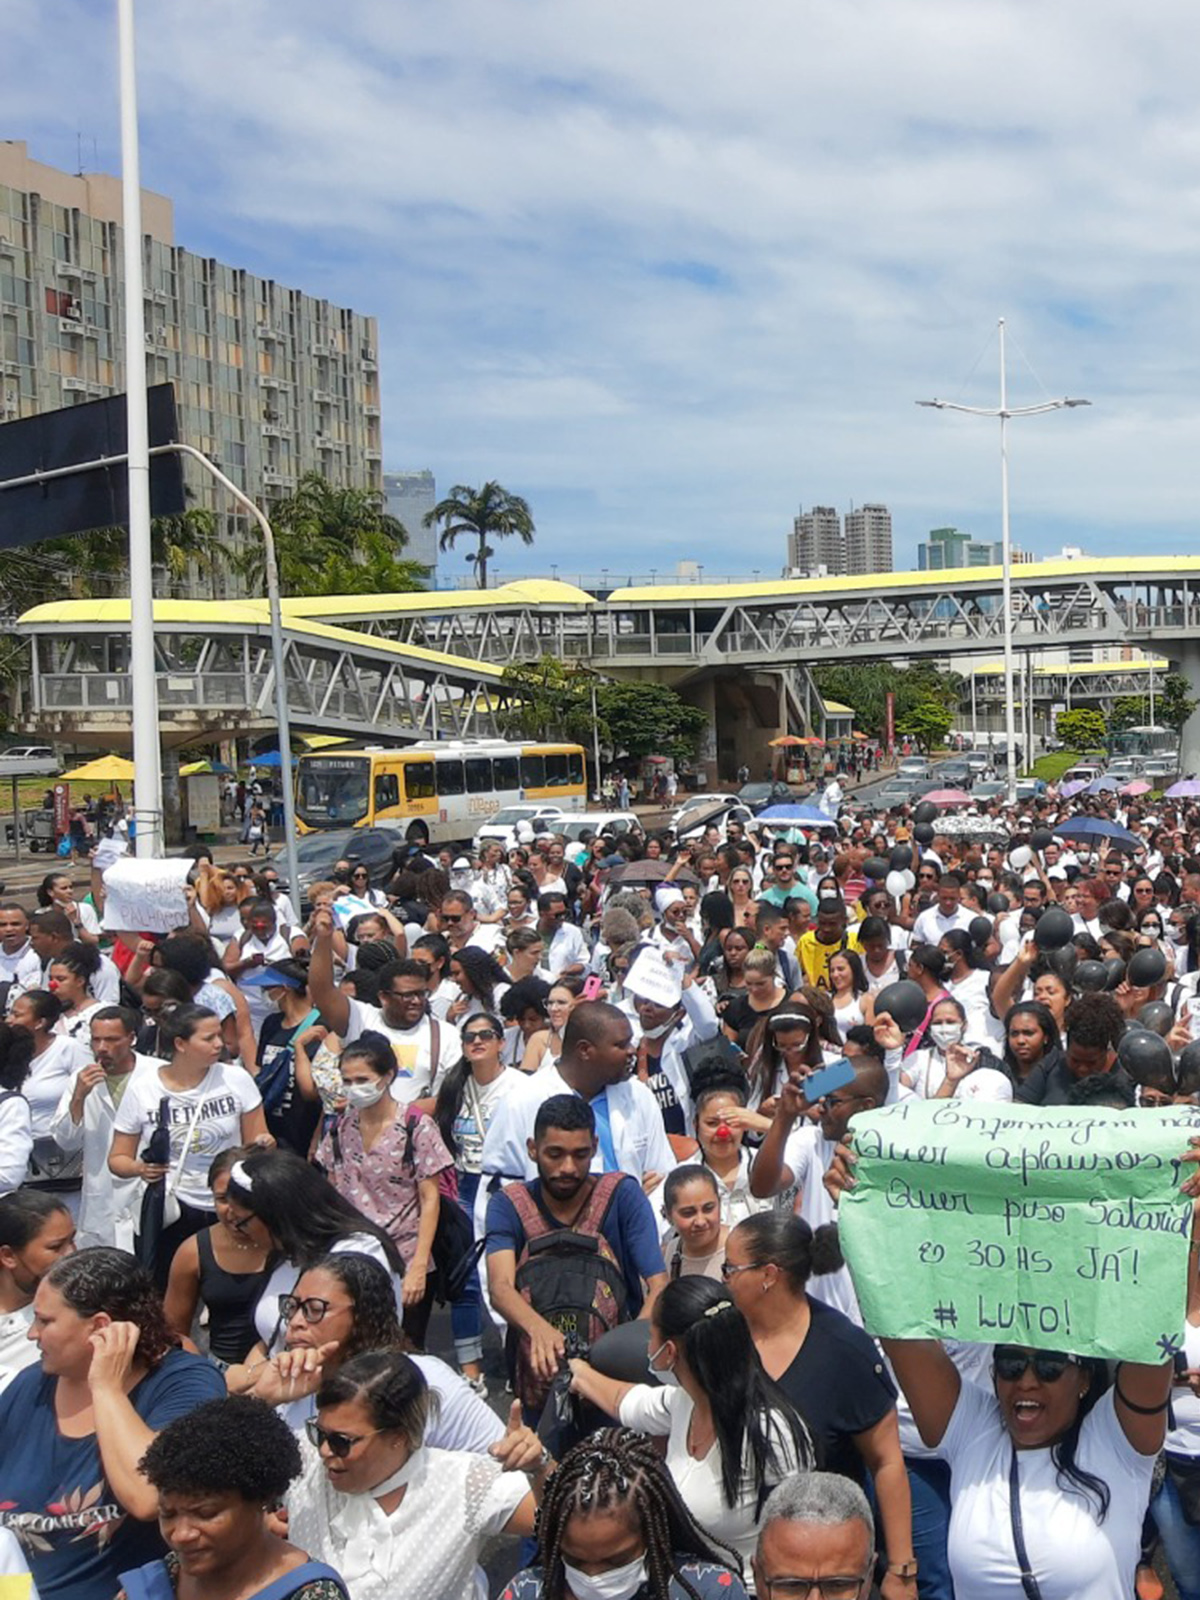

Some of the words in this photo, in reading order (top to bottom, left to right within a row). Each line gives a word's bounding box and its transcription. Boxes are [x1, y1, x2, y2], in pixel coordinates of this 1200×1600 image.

[879, 1103, 908, 1120] A
[933, 1102, 1138, 1145] Enfermagem
[1004, 1195, 1065, 1236] piso
[969, 1239, 1006, 1268] 30
[978, 1295, 1071, 1335] LUTO!
